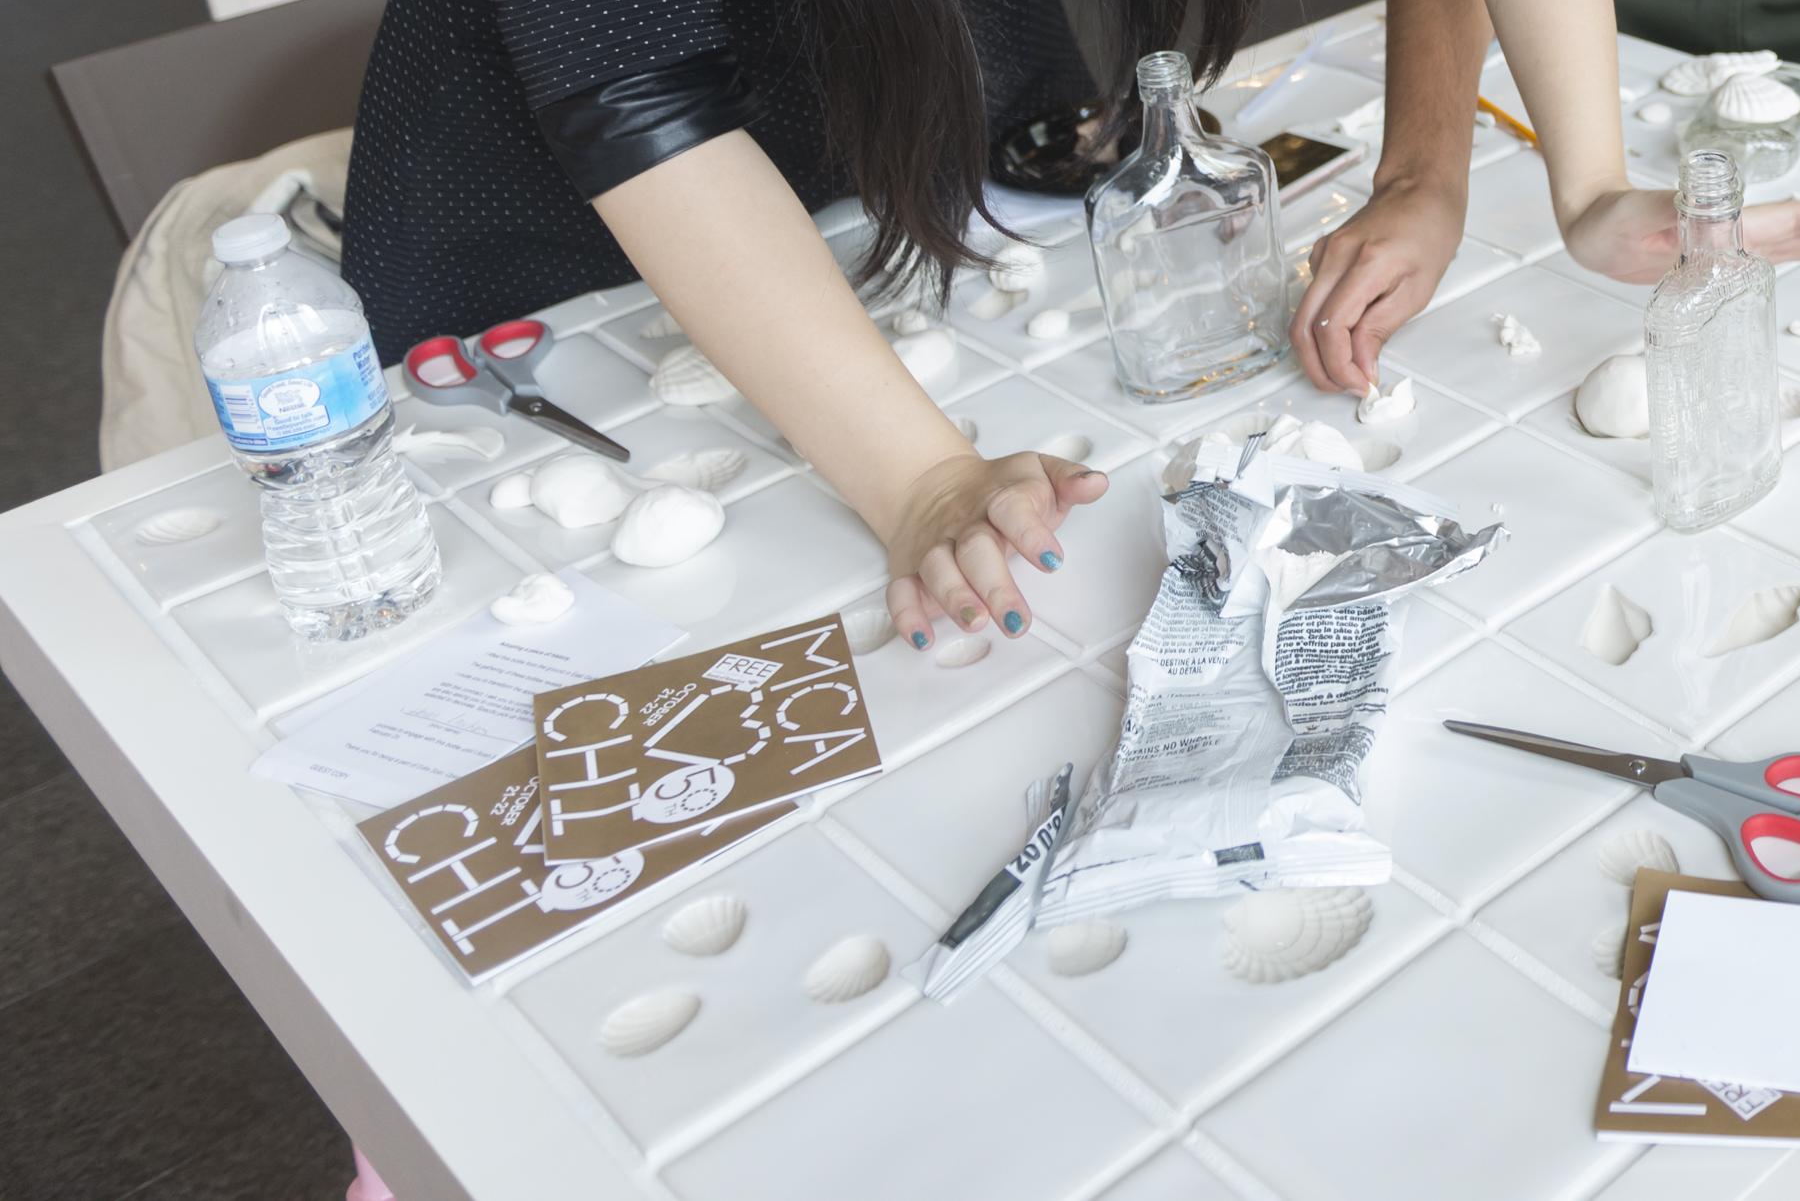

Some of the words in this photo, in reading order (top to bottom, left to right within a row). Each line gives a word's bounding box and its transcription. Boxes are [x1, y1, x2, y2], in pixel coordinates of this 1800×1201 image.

[1305, 613, 1333, 621] unique
[1333, 626, 1352, 635] pâte
[716, 655, 778, 678] FREE
[642, 683, 698, 727] OCTOBER
[1163, 741, 1177, 752] NO
[1009, 842, 1042, 874] OZ
